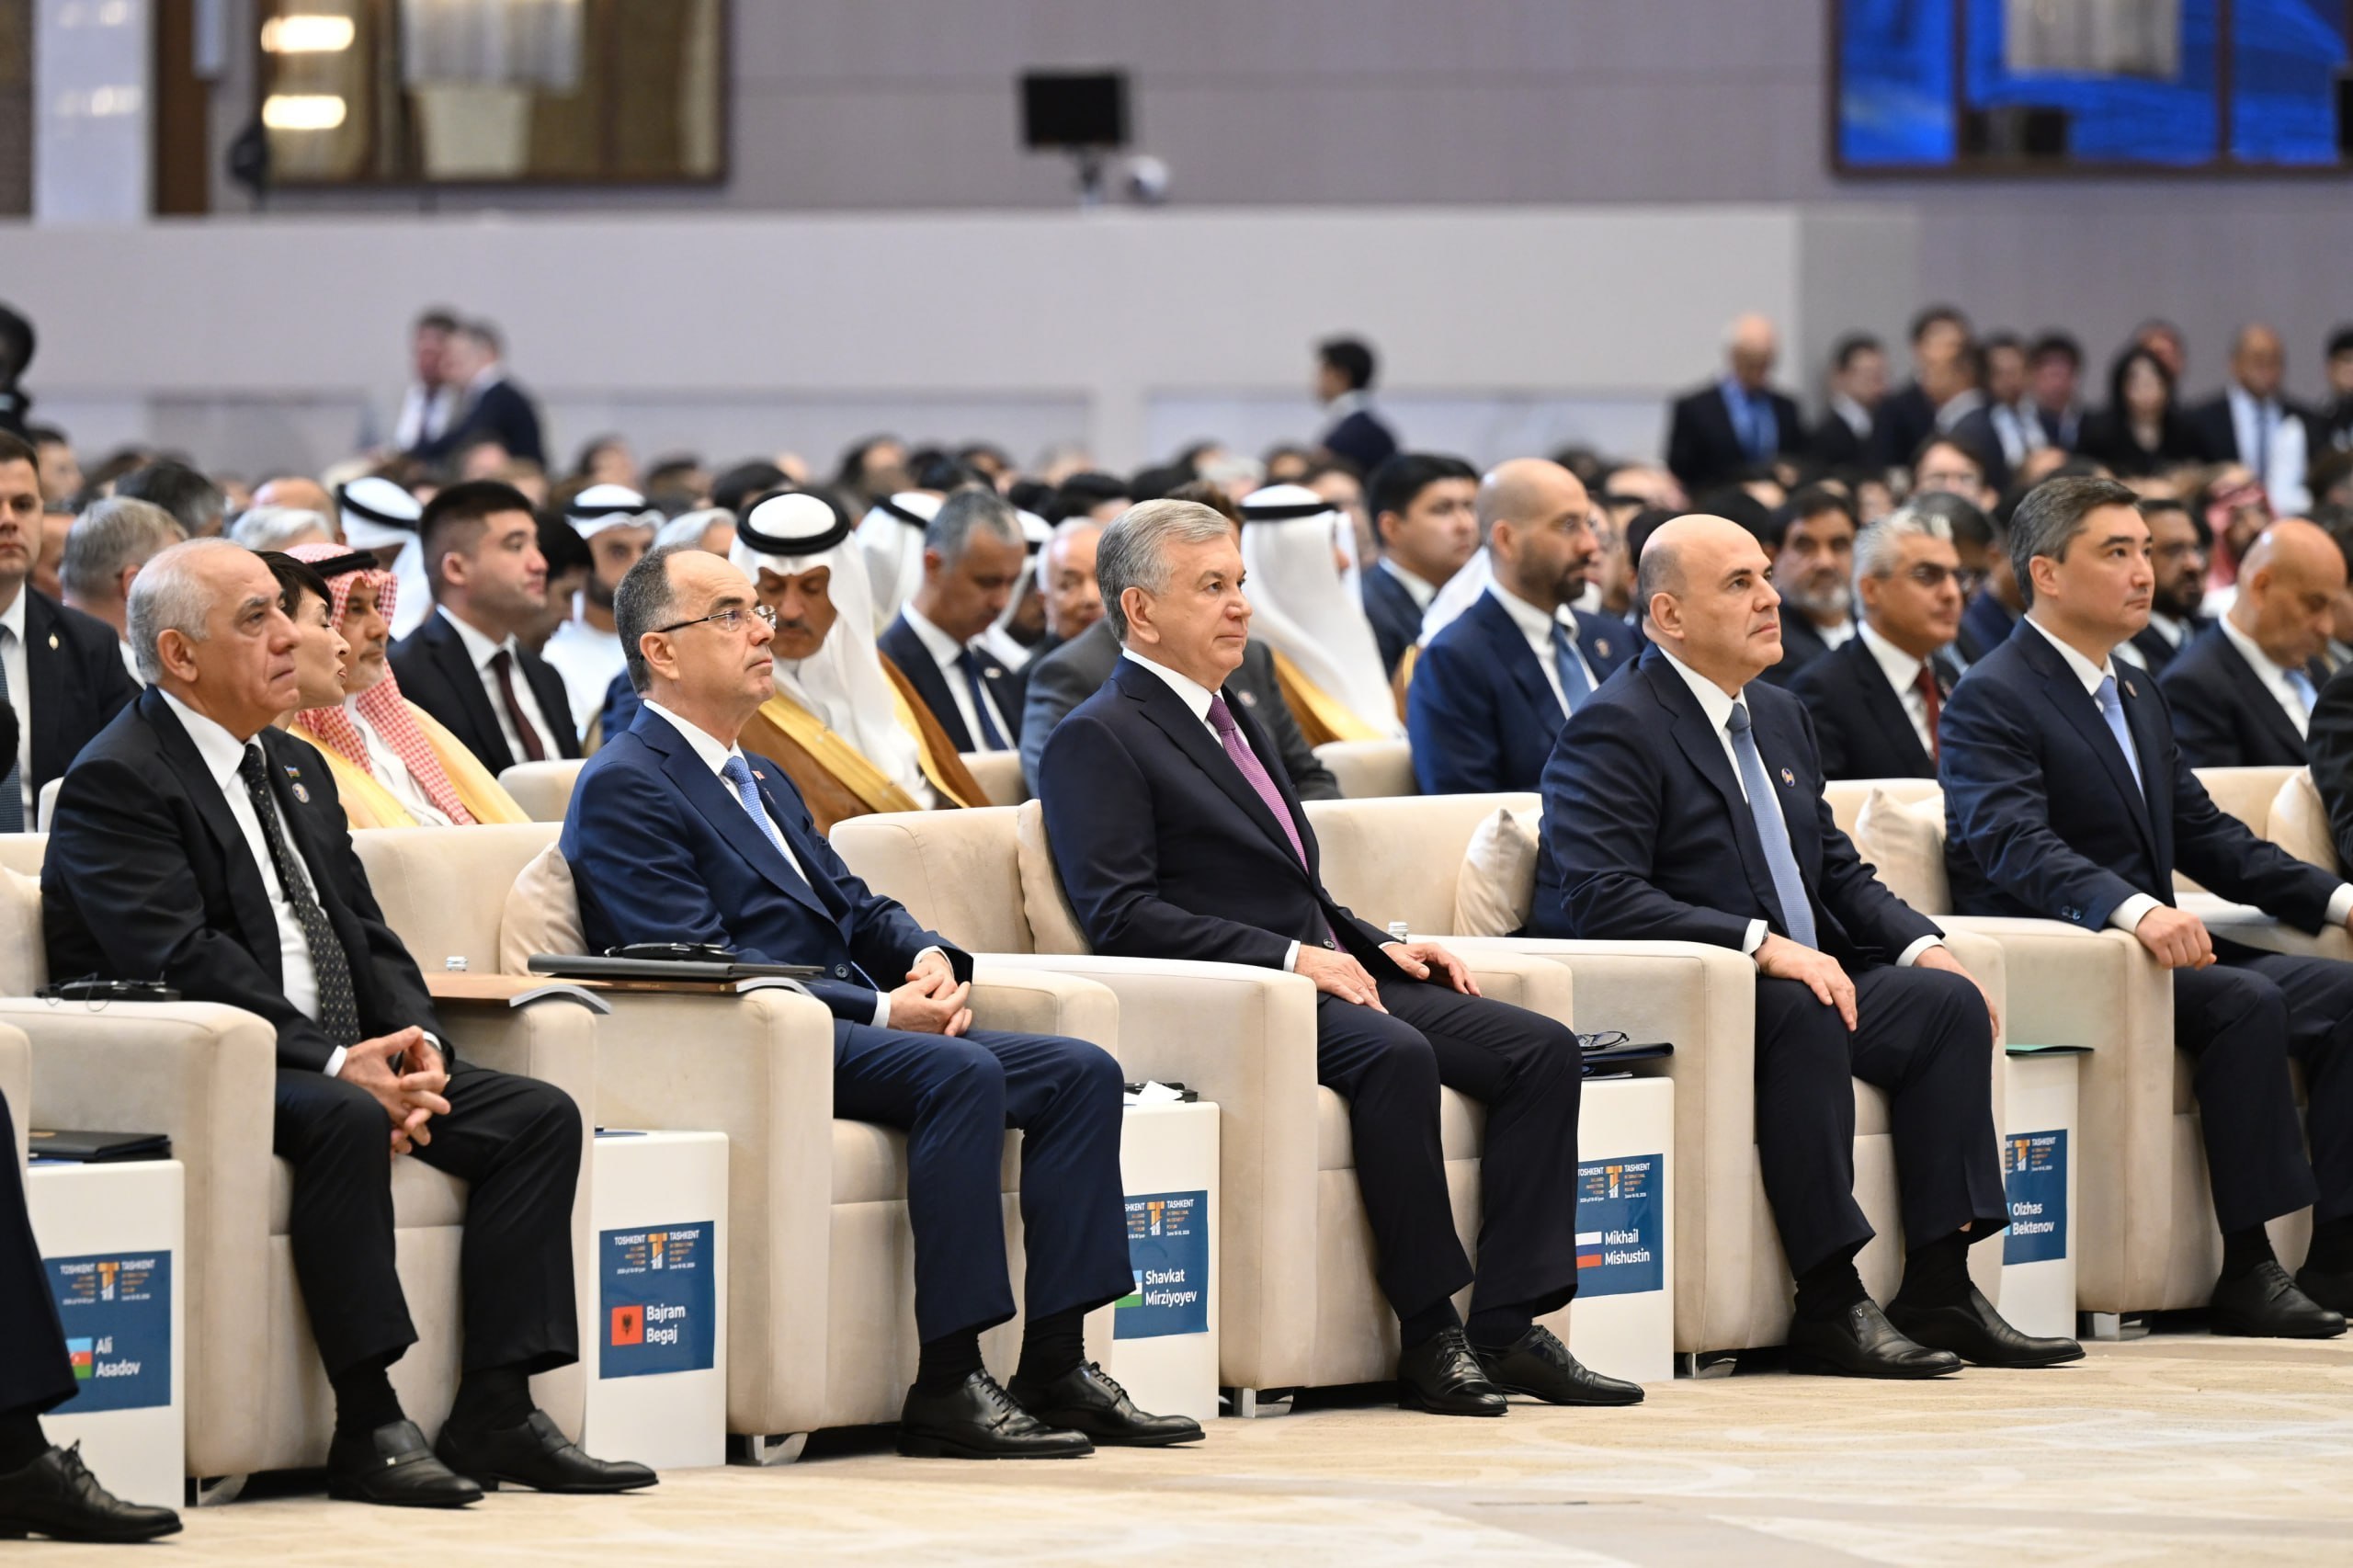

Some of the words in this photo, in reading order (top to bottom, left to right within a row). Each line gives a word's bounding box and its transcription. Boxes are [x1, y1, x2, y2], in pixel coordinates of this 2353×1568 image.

[1624, 1163, 1651, 1173] TASHKENT
[1124, 1202, 1145, 1212] SHKENT
[1166, 1199, 1194, 1209] TASHKENT
[2013, 1201, 2042, 1217] Olzhas
[669, 1230, 699, 1241] TASHKENT
[1605, 1228, 1639, 1245] Mikhail
[2013, 1221, 2054, 1235] Bektenov
[614, 1233, 645, 1246] TOSHKENT
[1605, 1247, 1650, 1266] Mishustin
[1145, 1268, 1185, 1285] Shavkat
[1145, 1289, 1198, 1308] Mirziyoyev
[646, 1303, 686, 1324] Bajram
[646, 1324, 677, 1345] Begaj
[96, 1335, 112, 1354] Ali
[96, 1359, 142, 1378] Asadov
